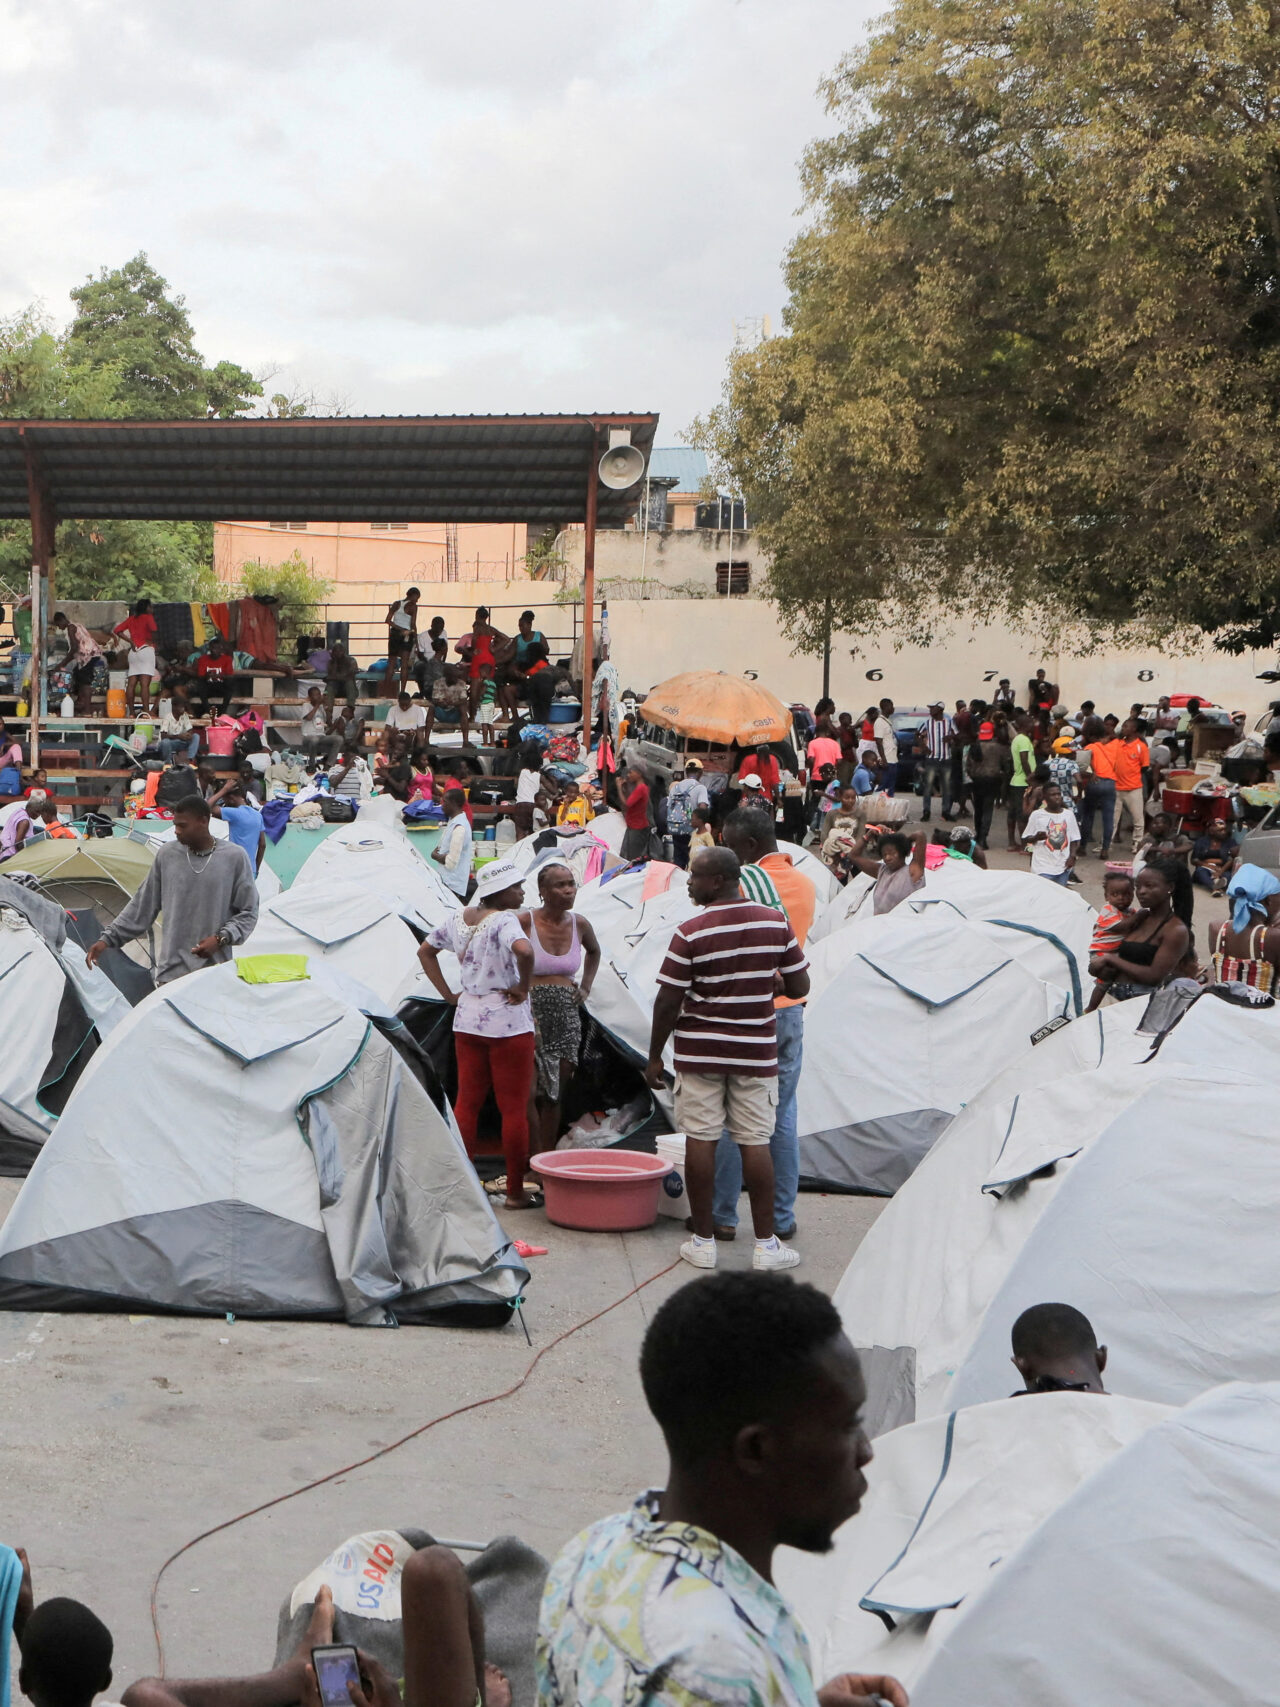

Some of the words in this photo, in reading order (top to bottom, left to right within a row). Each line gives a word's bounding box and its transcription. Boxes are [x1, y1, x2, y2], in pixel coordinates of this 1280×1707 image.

[743, 669, 759, 681] 5
[865, 668, 884, 682] 6
[982, 671, 999, 682] 7
[1137, 669, 1154, 682] 8
[753, 716, 775, 728] cash
[356, 1543, 395, 1609] USAID
